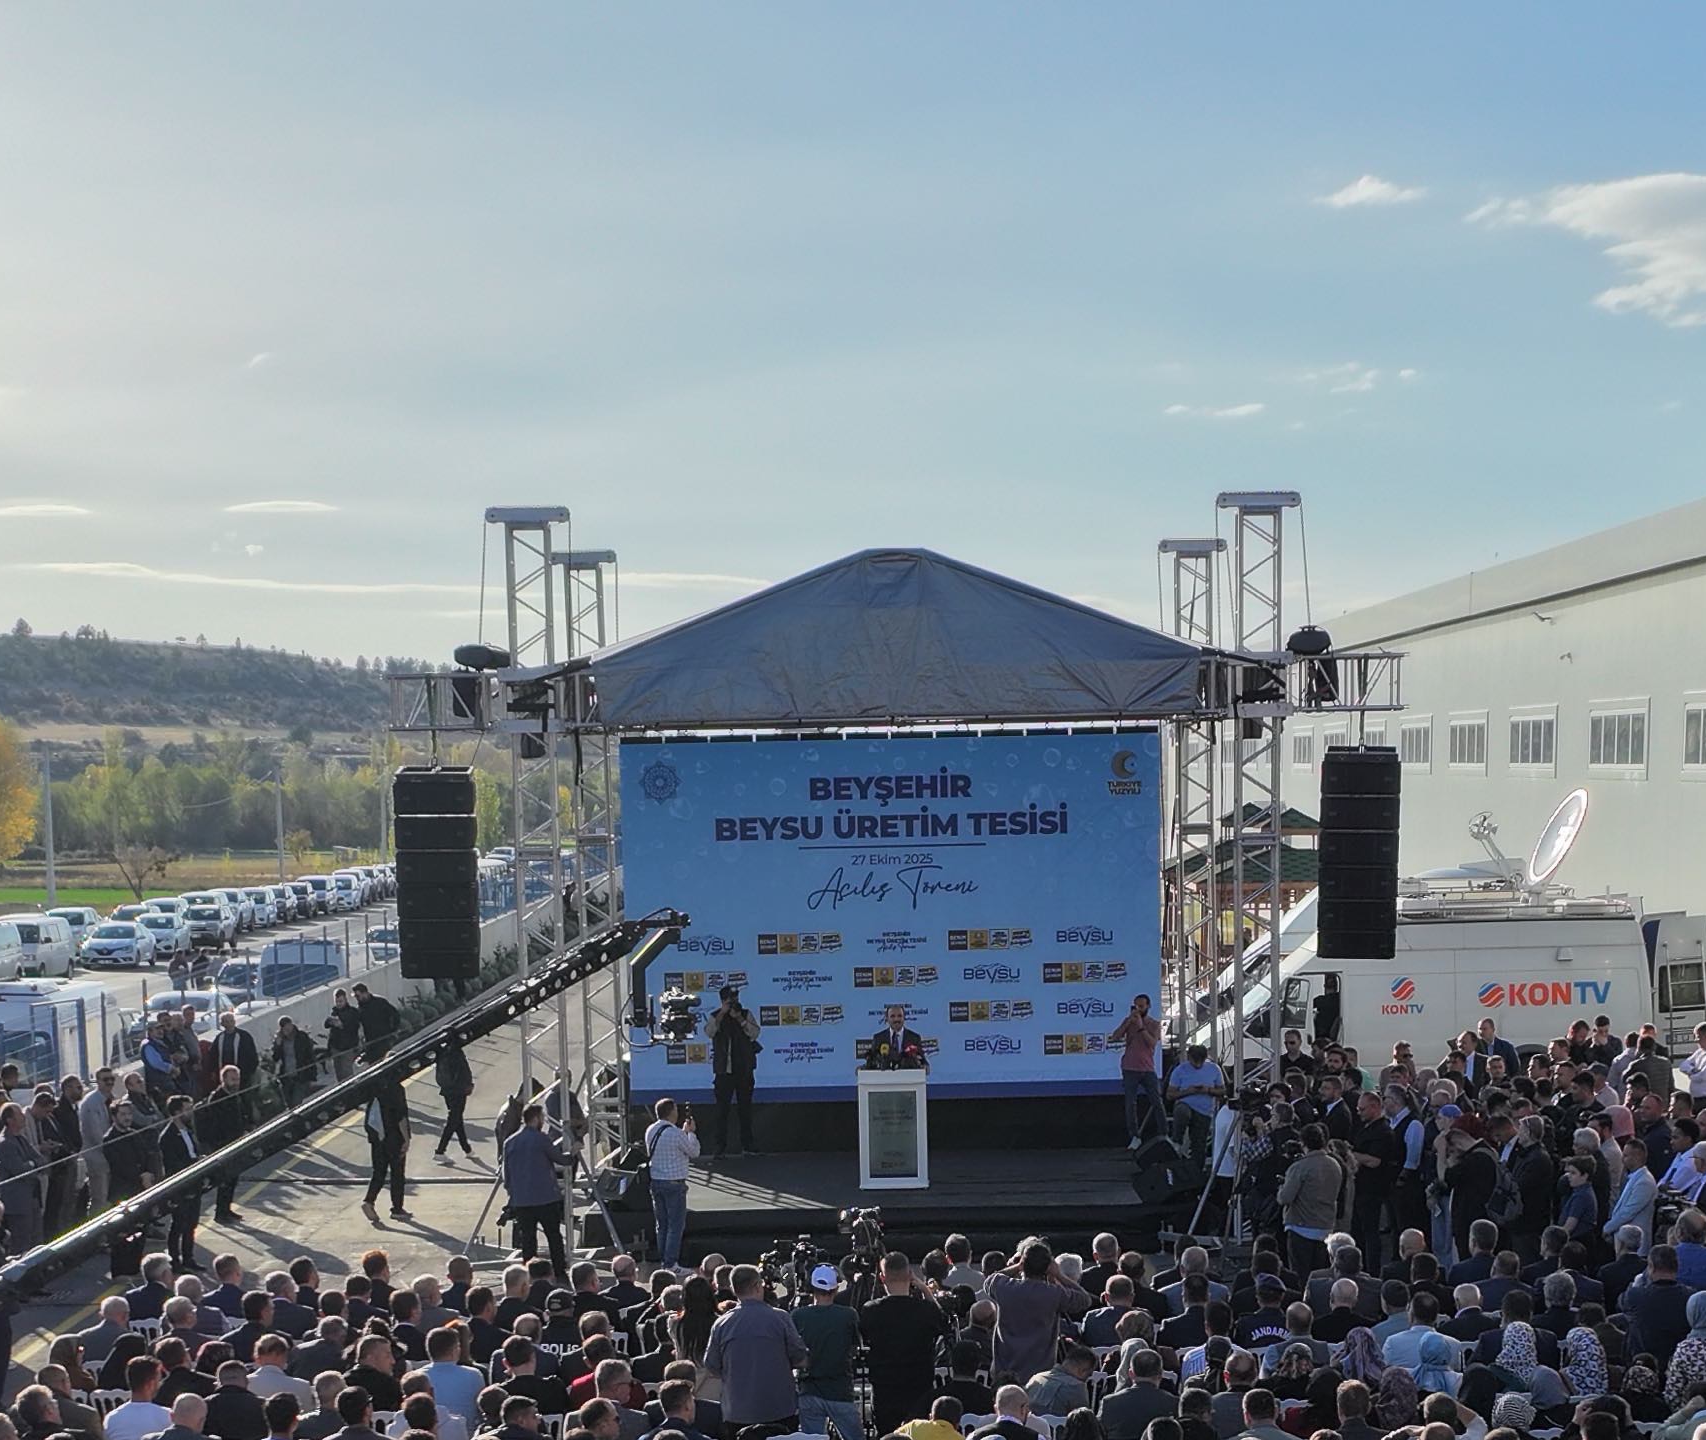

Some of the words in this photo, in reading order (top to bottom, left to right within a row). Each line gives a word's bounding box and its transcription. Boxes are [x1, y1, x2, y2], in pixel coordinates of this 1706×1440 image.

[809, 766, 972, 807] BEYŞEHİR
[715, 814, 823, 842] BEYSU
[834, 805, 958, 840] ÜRETİM
[967, 802, 1068, 836] TESİSİ
[851, 854, 866, 866] 27
[869, 853, 901, 865] Ekim
[904, 853, 934, 865] 2025
[808, 866, 892, 911] Açılış
[896, 865, 979, 911] Töreni
[1509, 981, 1611, 1006] KONTV
[1381, 1004, 1424, 1015] KONTV
[1251, 1326, 1291, 1341] JANDARM
